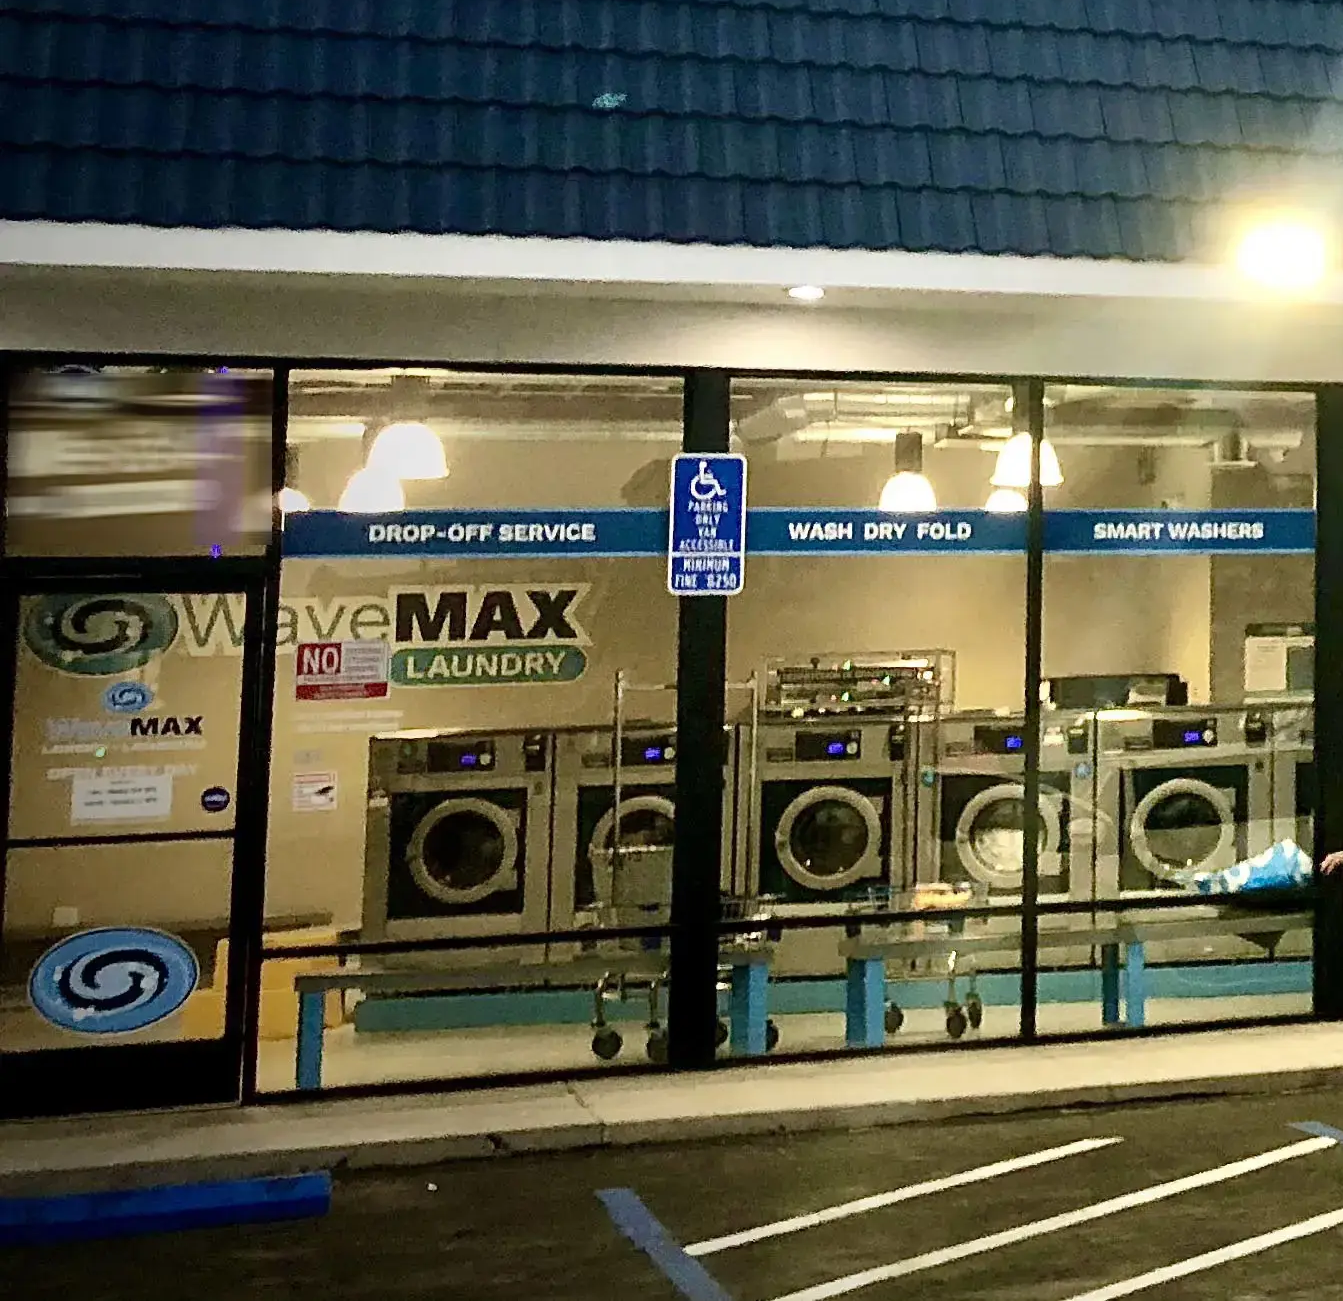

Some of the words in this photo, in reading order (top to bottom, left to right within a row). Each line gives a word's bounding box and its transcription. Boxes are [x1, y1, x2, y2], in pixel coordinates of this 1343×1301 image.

[687, 500, 729, 513] PARKING
[695, 513, 721, 526] ONLY
[368, 522, 494, 543] DROP-OFF
[498, 522, 597, 543] SERVICE
[698, 526, 717, 539] VAN
[788, 521, 853, 541] WASH
[863, 521, 908, 541] DRY
[916, 521, 972, 541] FOLD
[1093, 521, 1165, 540] SMART
[1167, 521, 1264, 540] WASHERS
[679, 538, 734, 552] ACCESSIBLE
[683, 558, 730, 572] MINIMUM
[674, 573, 698, 588] FINE
[706, 573, 737, 588] $250
[303, 647, 339, 675] NO
[405, 649, 567, 682] LAUNDRY
